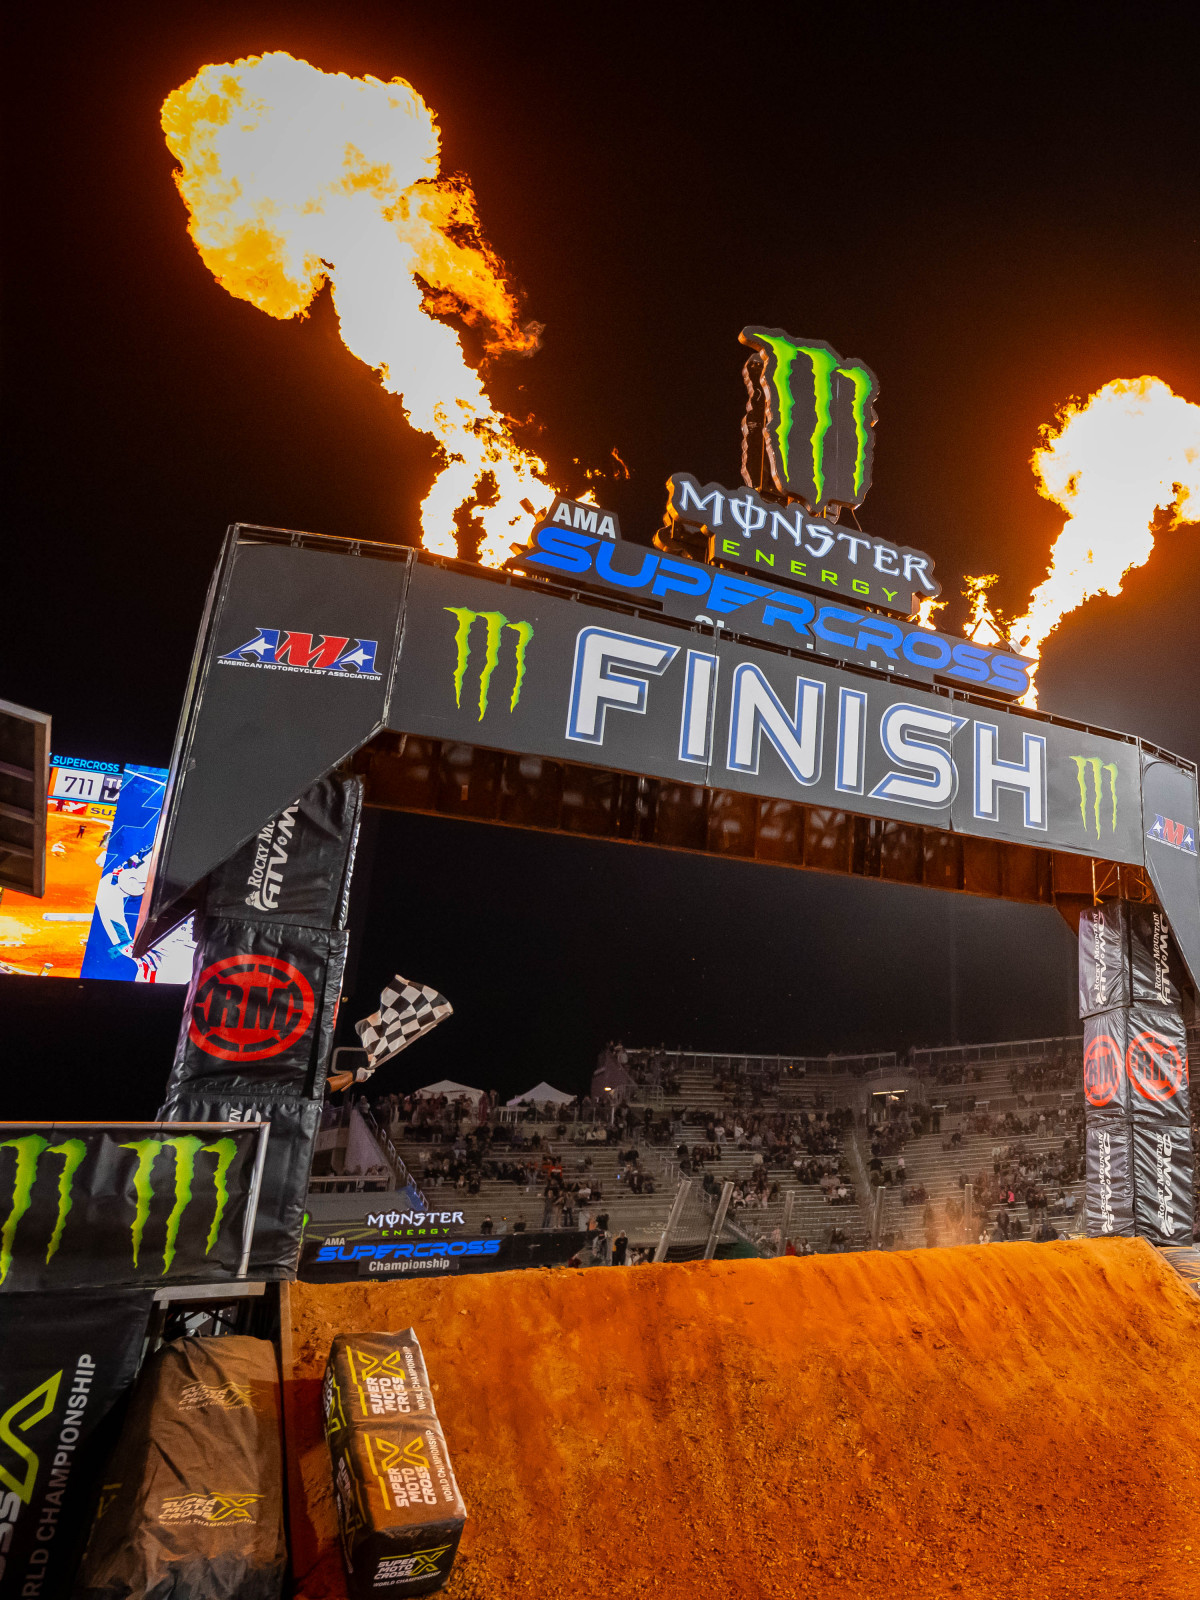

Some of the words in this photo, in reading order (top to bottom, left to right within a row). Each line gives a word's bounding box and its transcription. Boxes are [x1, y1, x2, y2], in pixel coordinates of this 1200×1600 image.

[552, 502, 617, 539] AMA
[722, 539, 898, 603] ENERGY
[526, 526, 1031, 693] SUPERCROSS
[217, 627, 383, 676] AMA
[217, 659, 263, 669] AMERICAN
[263, 664, 327, 676] MOTORCYCLIST
[328, 671, 381, 681] ASSOCIATION
[565, 625, 1047, 831] FINISH
[52, 755, 120, 773] SUPERCROSS
[64, 776, 94, 796] 711
[1146, 813, 1198, 853] AMA
[247, 843, 271, 889] ROCKY
[1152, 912, 1161, 961] MOUNTAIN
[1154, 961, 1162, 990] ROCKY
[316, 1239, 502, 1262] SUPERCROSS
[324, 1237, 346, 1246] AMA
[381, 1228, 450, 1237] ENERGY
[369, 1257, 450, 1272] Championship
[36, 1354, 96, 1541] CHAMPIONSHIP
[426, 1429, 447, 1479] CHAMPIONSHIP
[387, 1467, 409, 1507] SUPER
[402, 1468, 423, 1503] MOTO
[415, 1466, 437, 1505] CROSS
[437, 1476, 455, 1502] WORLD
